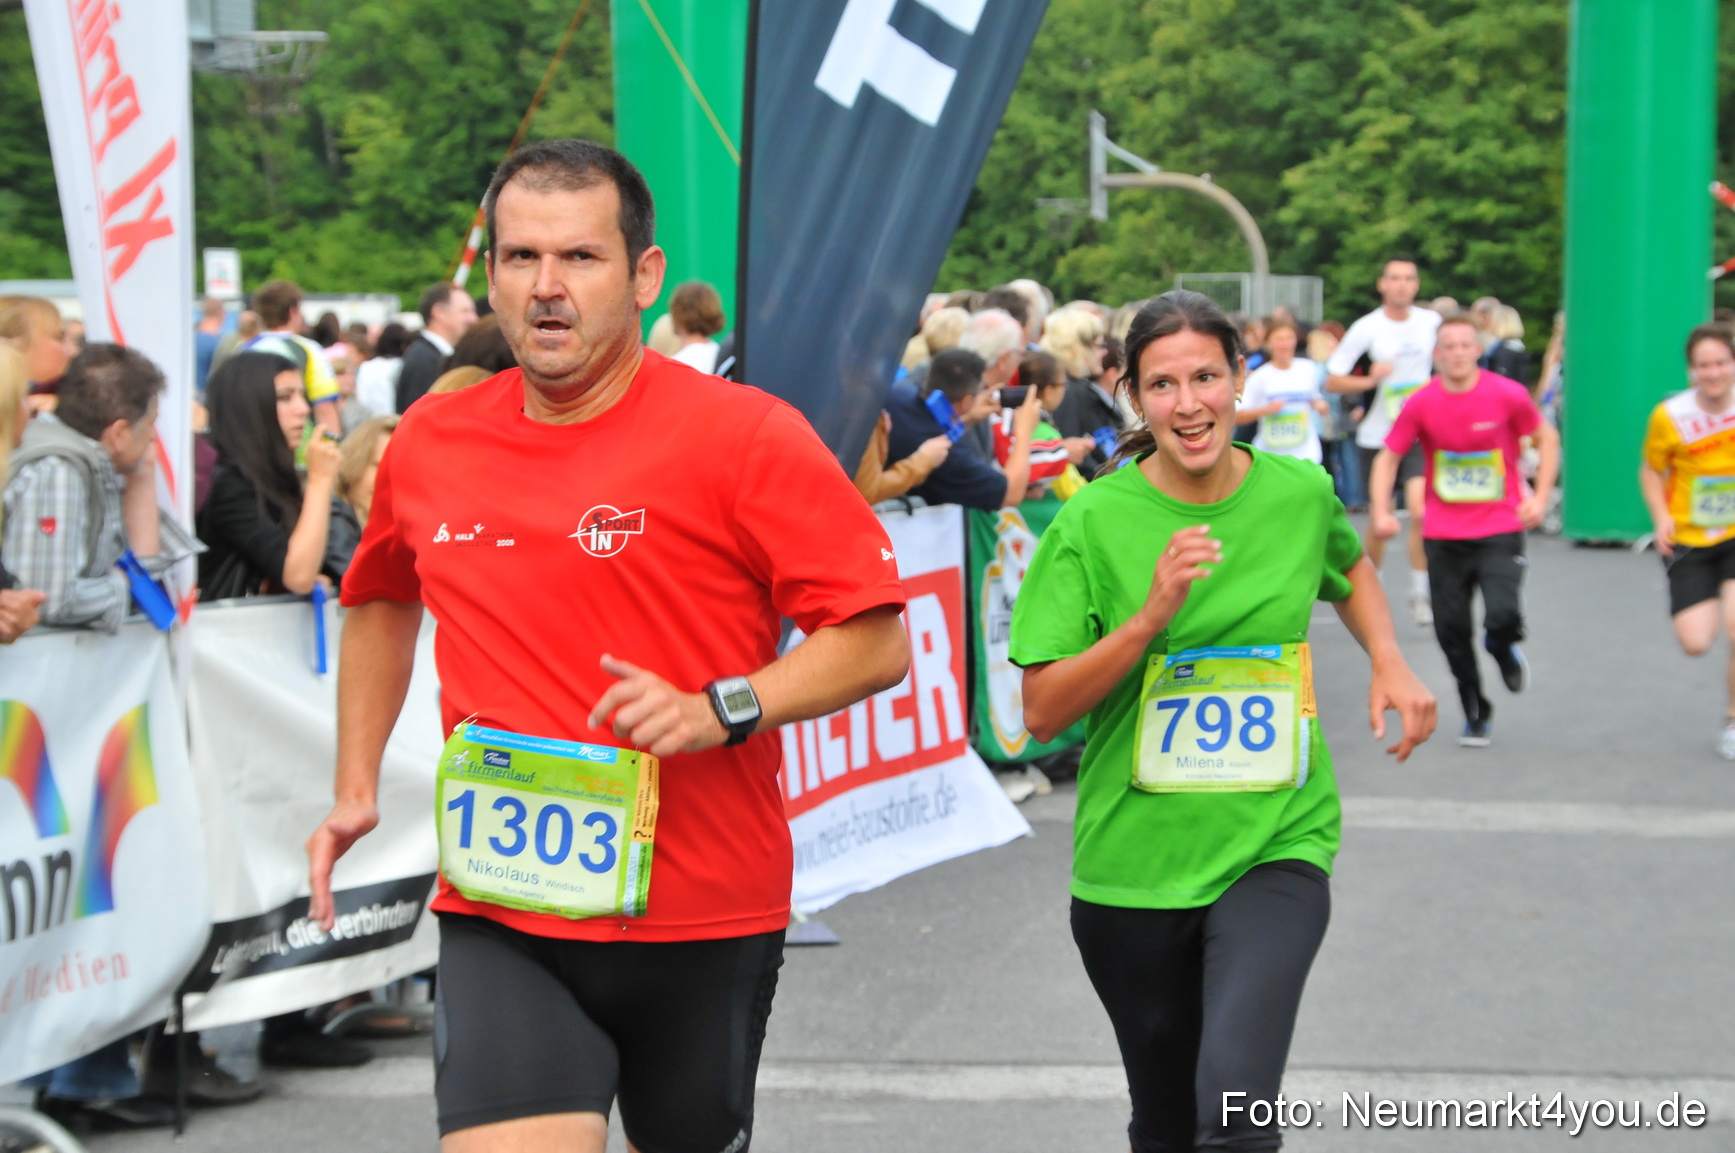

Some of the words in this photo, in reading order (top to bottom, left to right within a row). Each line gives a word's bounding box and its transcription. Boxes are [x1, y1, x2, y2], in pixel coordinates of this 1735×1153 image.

[1446, 465, 1491, 489] 342
[1157, 695, 1277, 754] 798
[467, 761, 537, 784] firmenlauf
[1176, 756, 1225, 769] Milena
[447, 789, 618, 874] 1303
[467, 858, 541, 885] Nikolaus
[545, 880, 585, 894] Windisch
[286, 917, 329, 950] die
